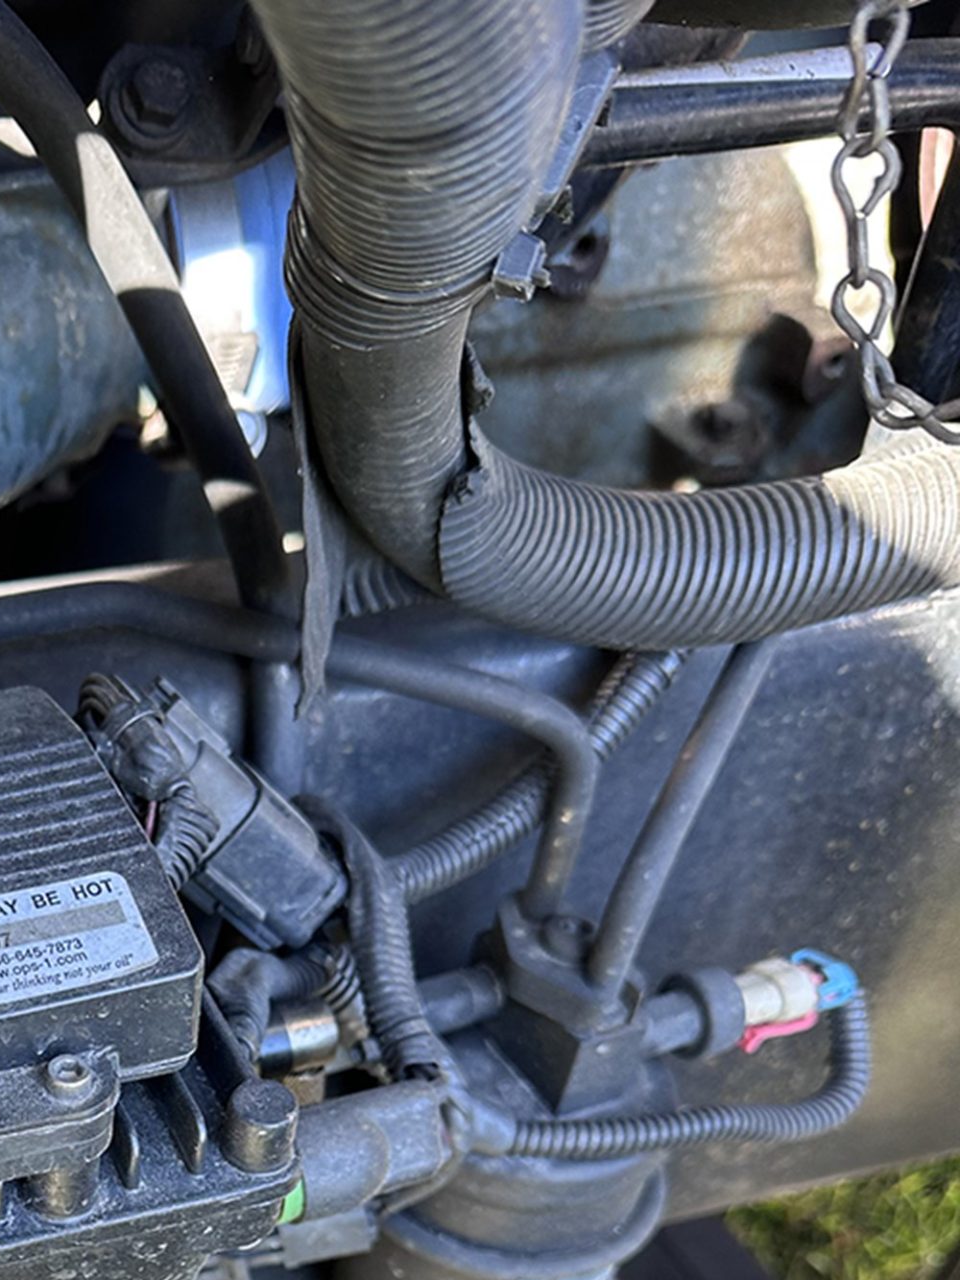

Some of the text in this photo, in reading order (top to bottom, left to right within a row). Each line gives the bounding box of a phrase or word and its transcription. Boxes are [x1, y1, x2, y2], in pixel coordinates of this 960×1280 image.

[31, 890, 61, 910] BE
[72, 878, 113, 900] HOT
[13, 972, 62, 990] thinking
[64, 967, 83, 979] not
[86, 962, 111, 978] your
